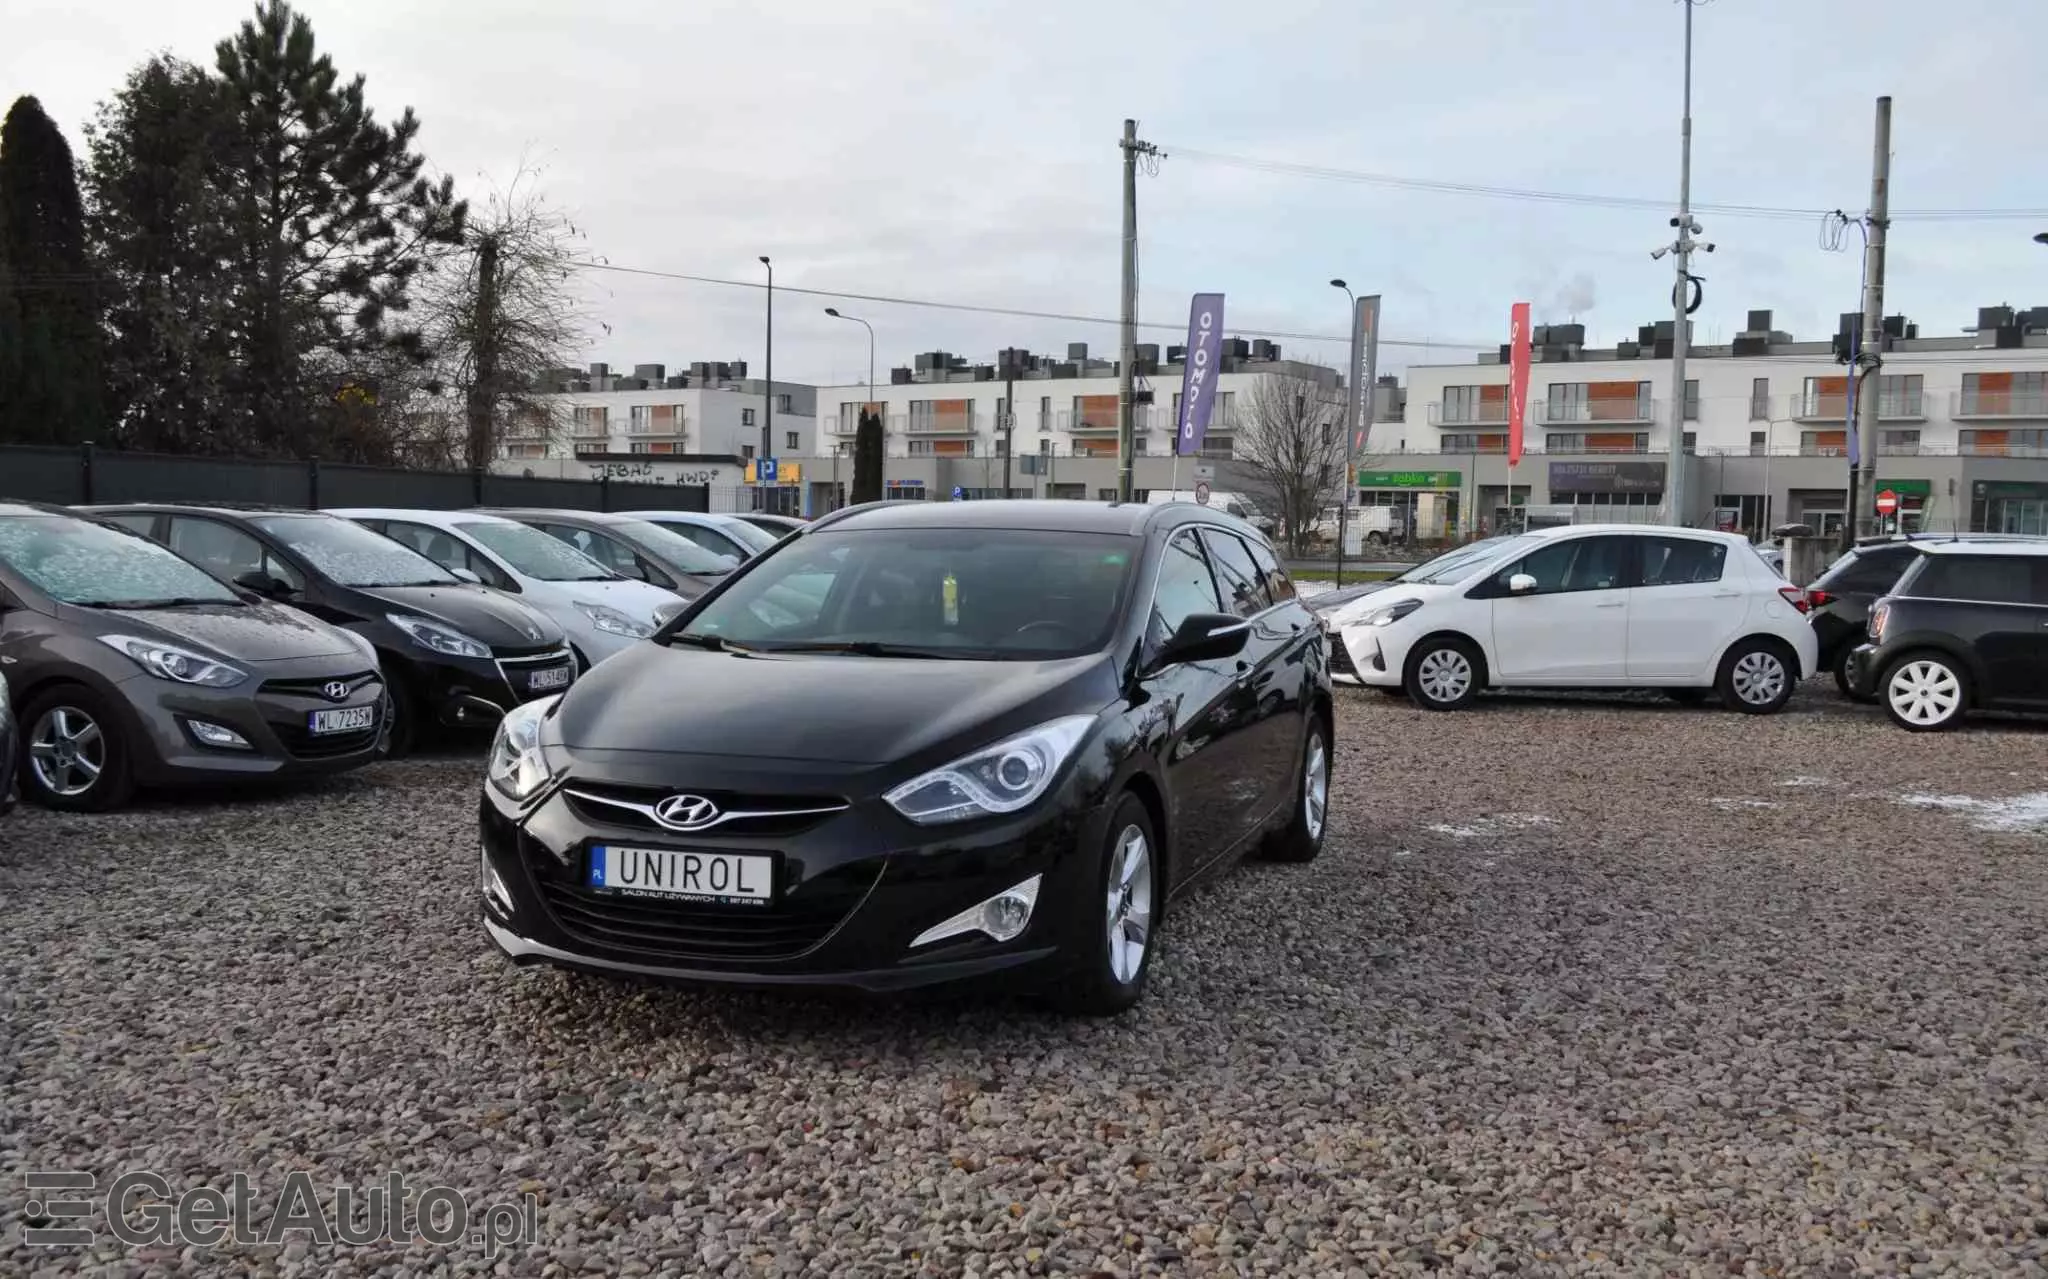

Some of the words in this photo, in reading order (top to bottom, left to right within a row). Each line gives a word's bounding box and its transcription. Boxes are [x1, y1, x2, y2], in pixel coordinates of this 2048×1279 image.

[318, 711, 334, 730] WL
[338, 706, 371, 729] 7235W
[592, 868, 603, 880] PL
[620, 850, 755, 893] UNIROL
[621, 888, 649, 898] SALON
